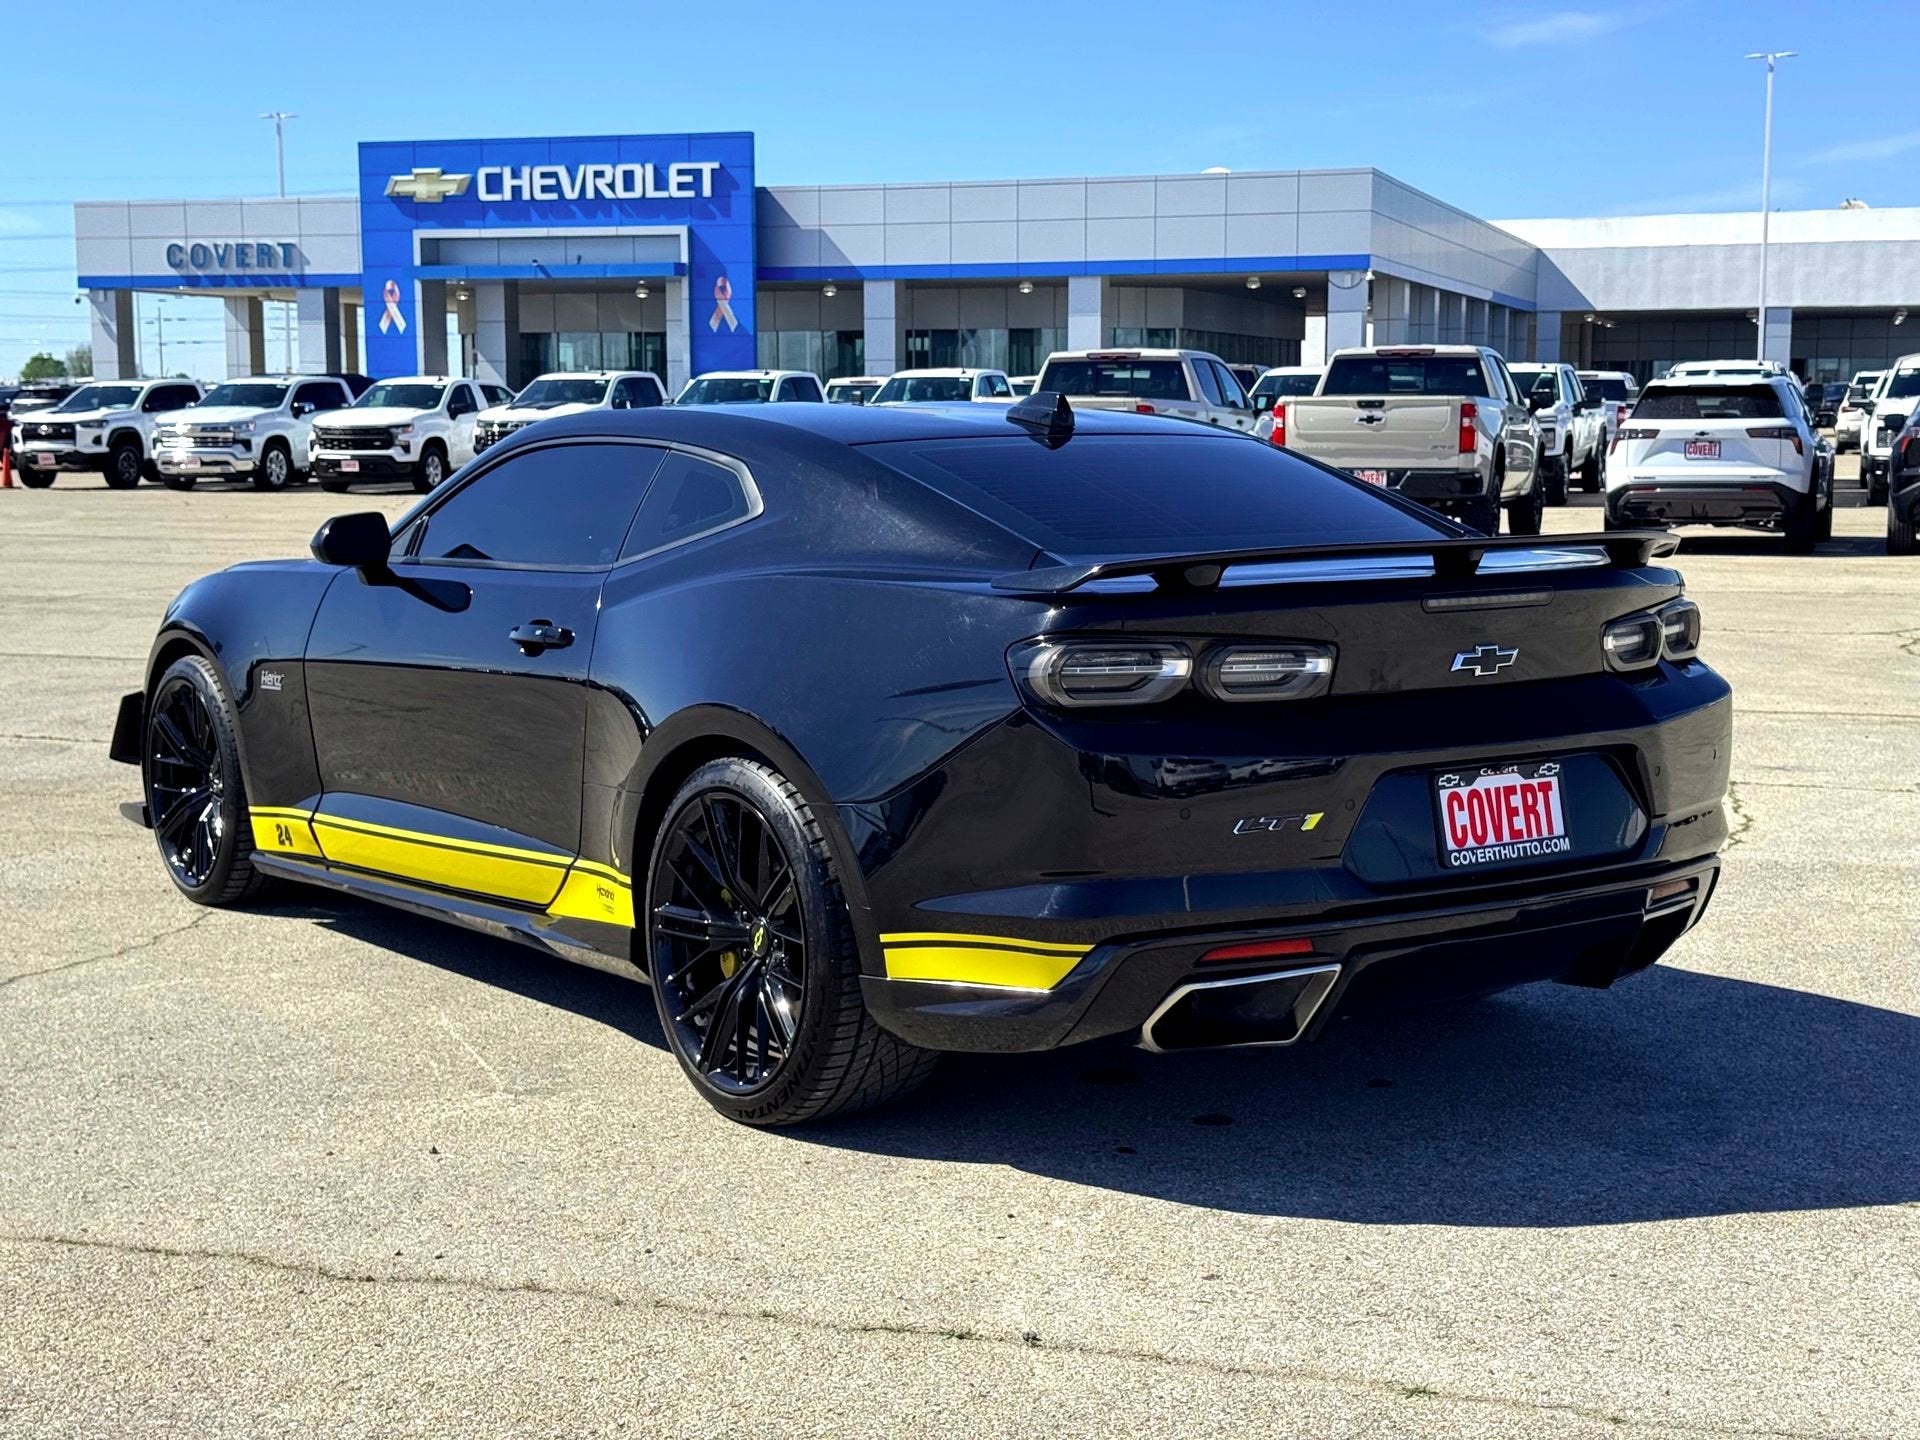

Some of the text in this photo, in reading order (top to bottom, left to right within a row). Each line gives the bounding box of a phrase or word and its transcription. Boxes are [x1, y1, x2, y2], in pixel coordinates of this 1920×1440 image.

[477, 161, 720, 202] CHEVROLET
[167, 242, 296, 269] COVERT
[1687, 444, 1718, 457] COVERT
[261, 670, 282, 687] Hertz
[1480, 765, 1518, 776] Cort
[1233, 811, 1325, 835] LT1
[1447, 780, 1554, 849] COVERT
[275, 823, 294, 847] 24
[1451, 837, 1571, 866] COVERTHUTTO.COM
